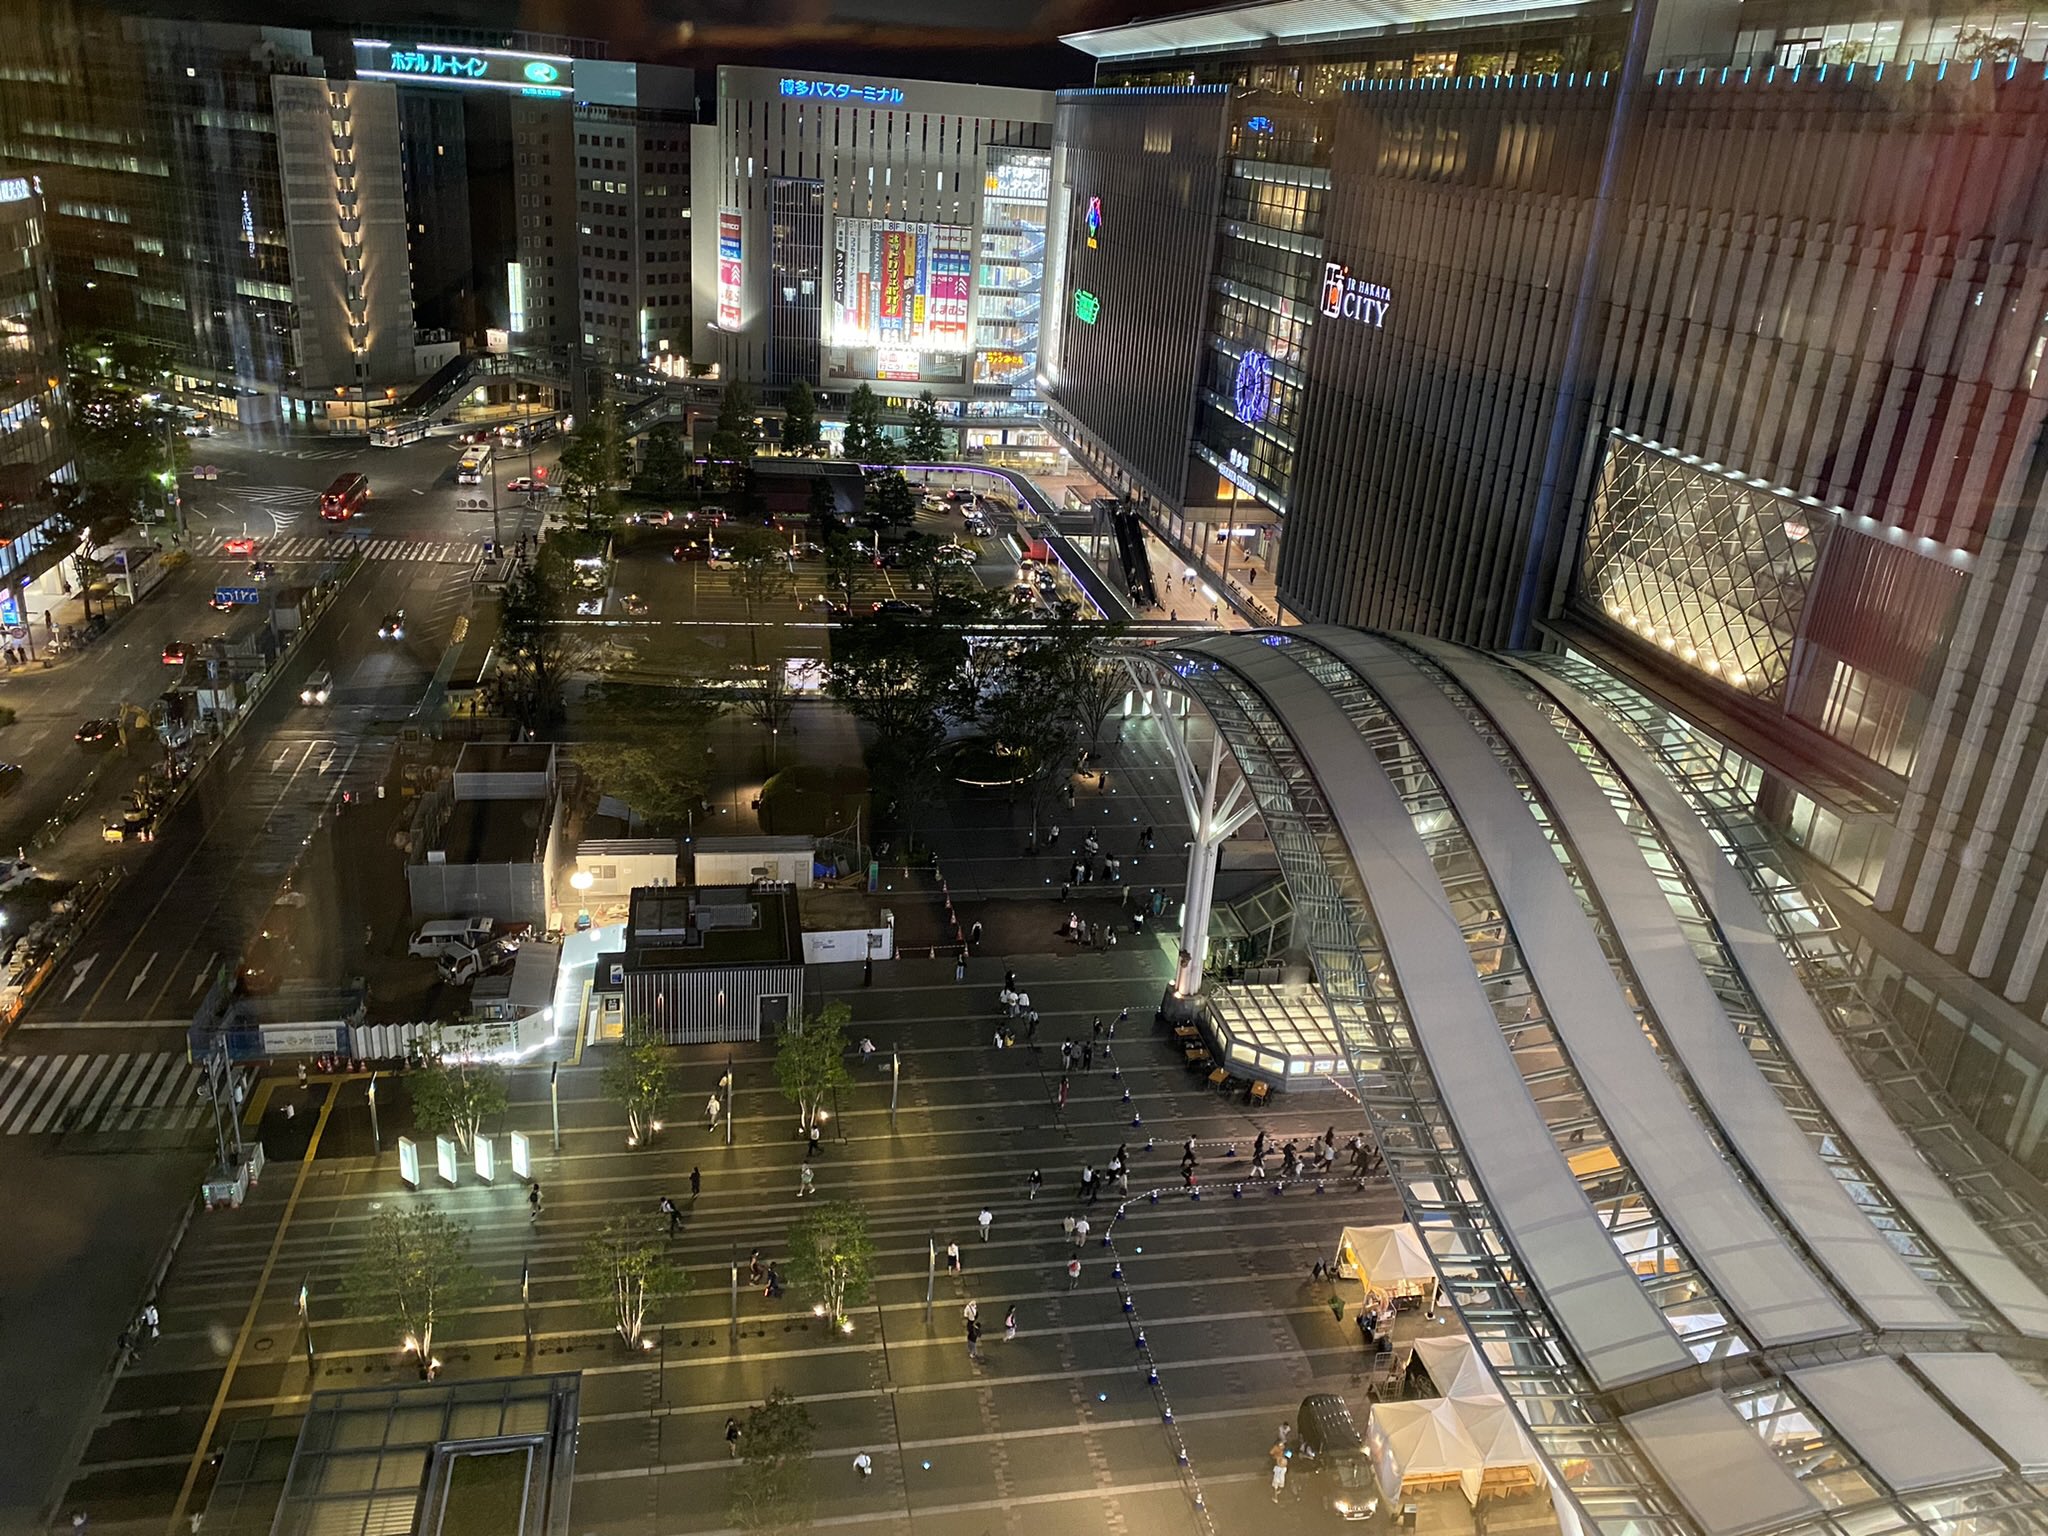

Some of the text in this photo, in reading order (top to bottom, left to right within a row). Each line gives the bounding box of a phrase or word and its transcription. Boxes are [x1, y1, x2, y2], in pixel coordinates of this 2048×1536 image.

[391, 52, 488, 77] ホテル ルートイン
[780, 78, 904, 103] 博多バスターミナル
[888, 222, 901, 230] 8F
[935, 234, 968, 243] namco
[1347, 277, 1391, 301] JR HAKATA
[931, 303, 967, 317] しまむら
[1343, 292, 1390, 328] CITY
